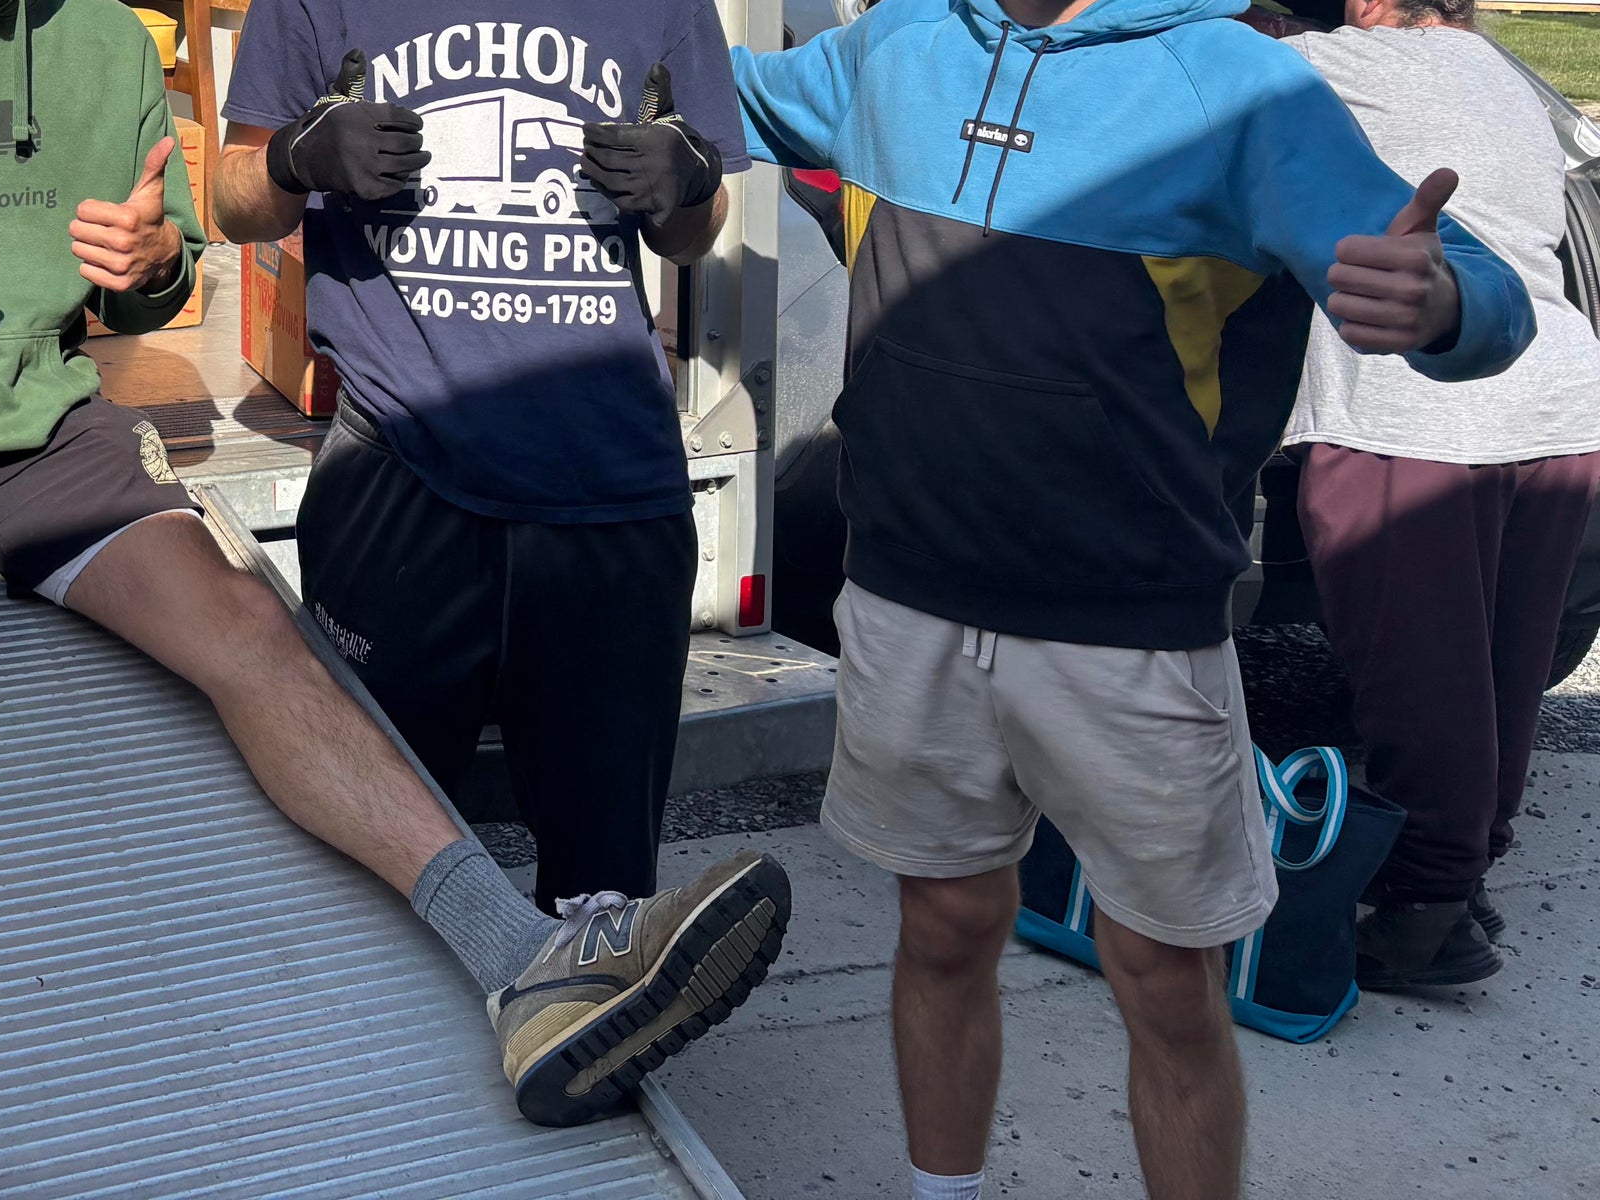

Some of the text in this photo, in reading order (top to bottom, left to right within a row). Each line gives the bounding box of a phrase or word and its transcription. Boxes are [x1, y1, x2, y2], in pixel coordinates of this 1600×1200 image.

[371, 21, 623, 118] NICHOLS
[364, 224, 626, 274] MOVING PRO
